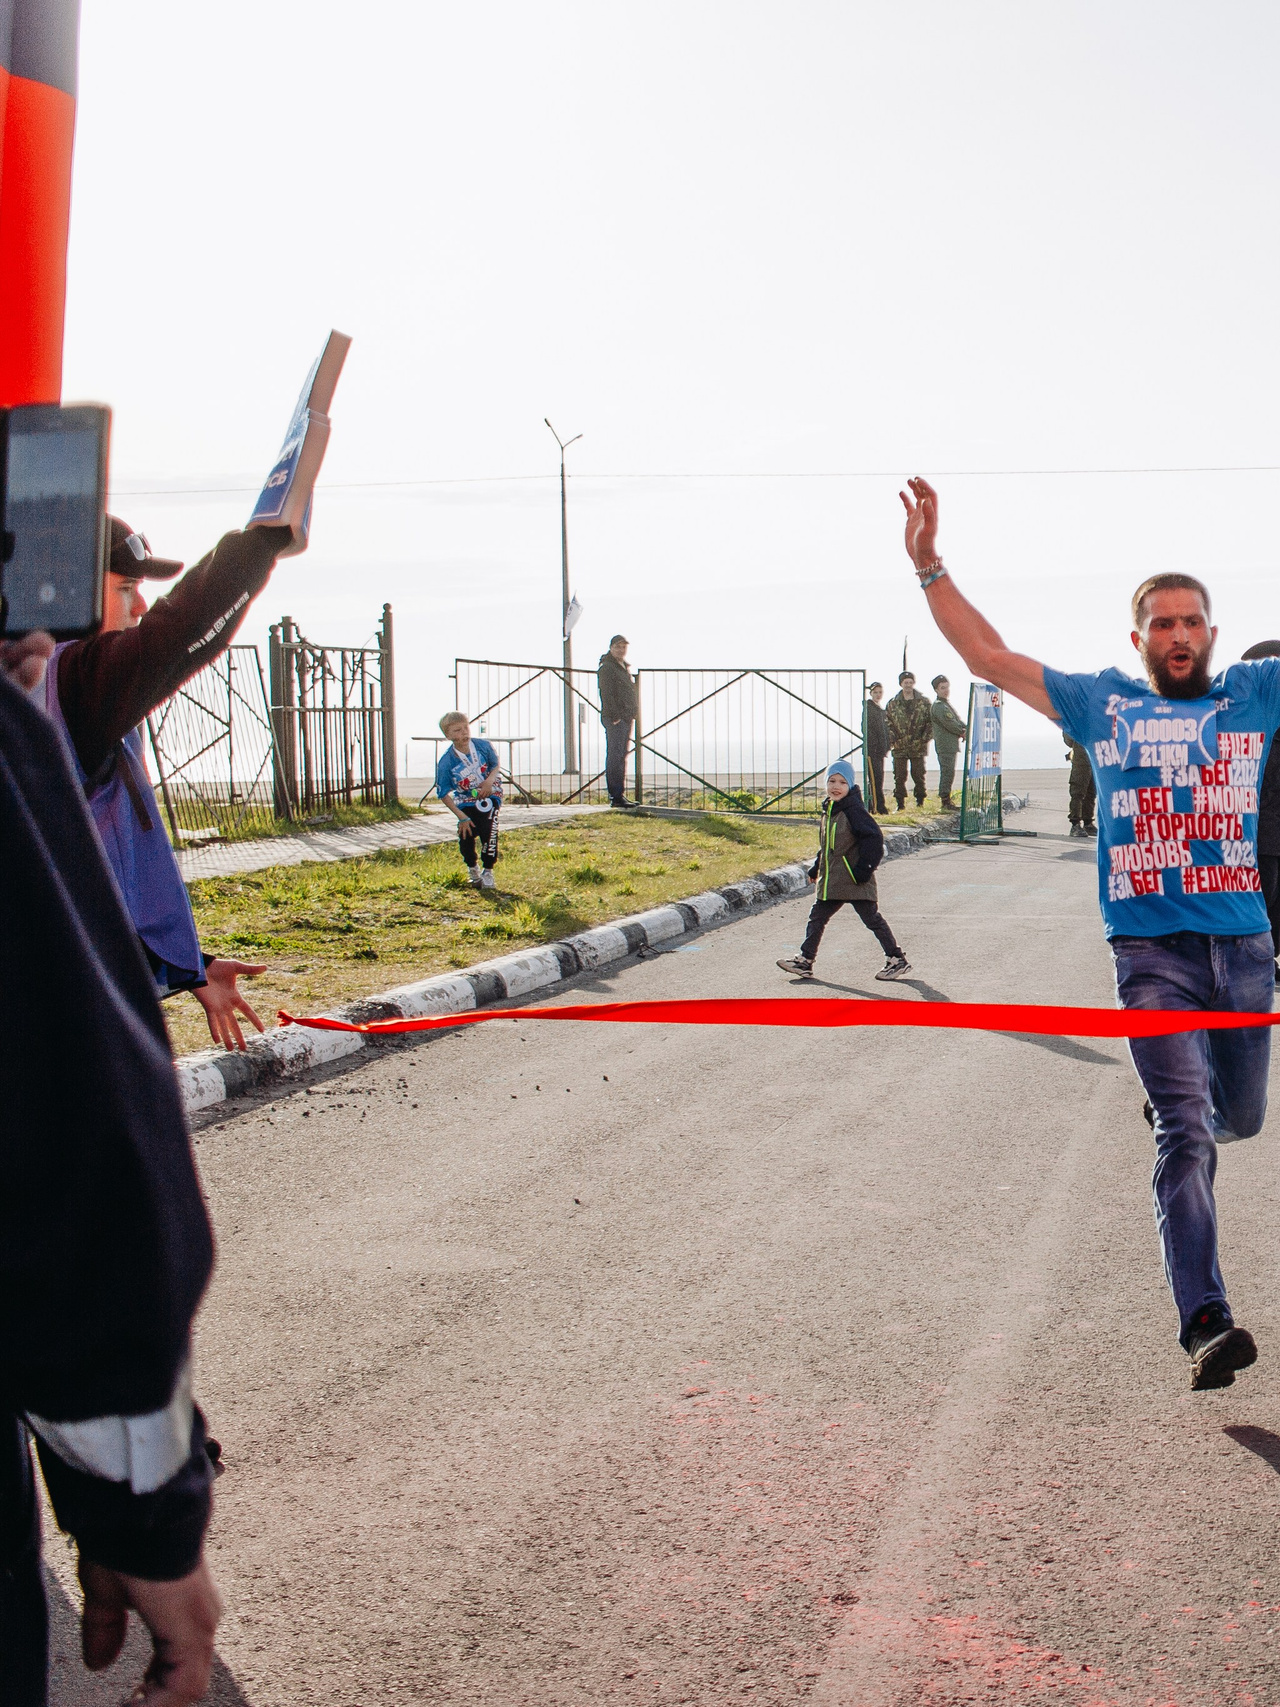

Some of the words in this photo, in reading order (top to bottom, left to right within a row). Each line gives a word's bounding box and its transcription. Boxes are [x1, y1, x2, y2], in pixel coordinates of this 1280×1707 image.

[1132, 718, 1198, 743] 40003
[1217, 732, 1265, 760] #ЦЕЛЬ
[1111, 787, 1174, 818] #ЗАБЕГ
[487, 809, 500, 858] COMMENT
[1133, 813, 1243, 842] #ГОРДОСТЬ
[1109, 841, 1193, 876] #ЛЮБОВЬ
[1108, 870, 1164, 902] #ЗАБЕГ
